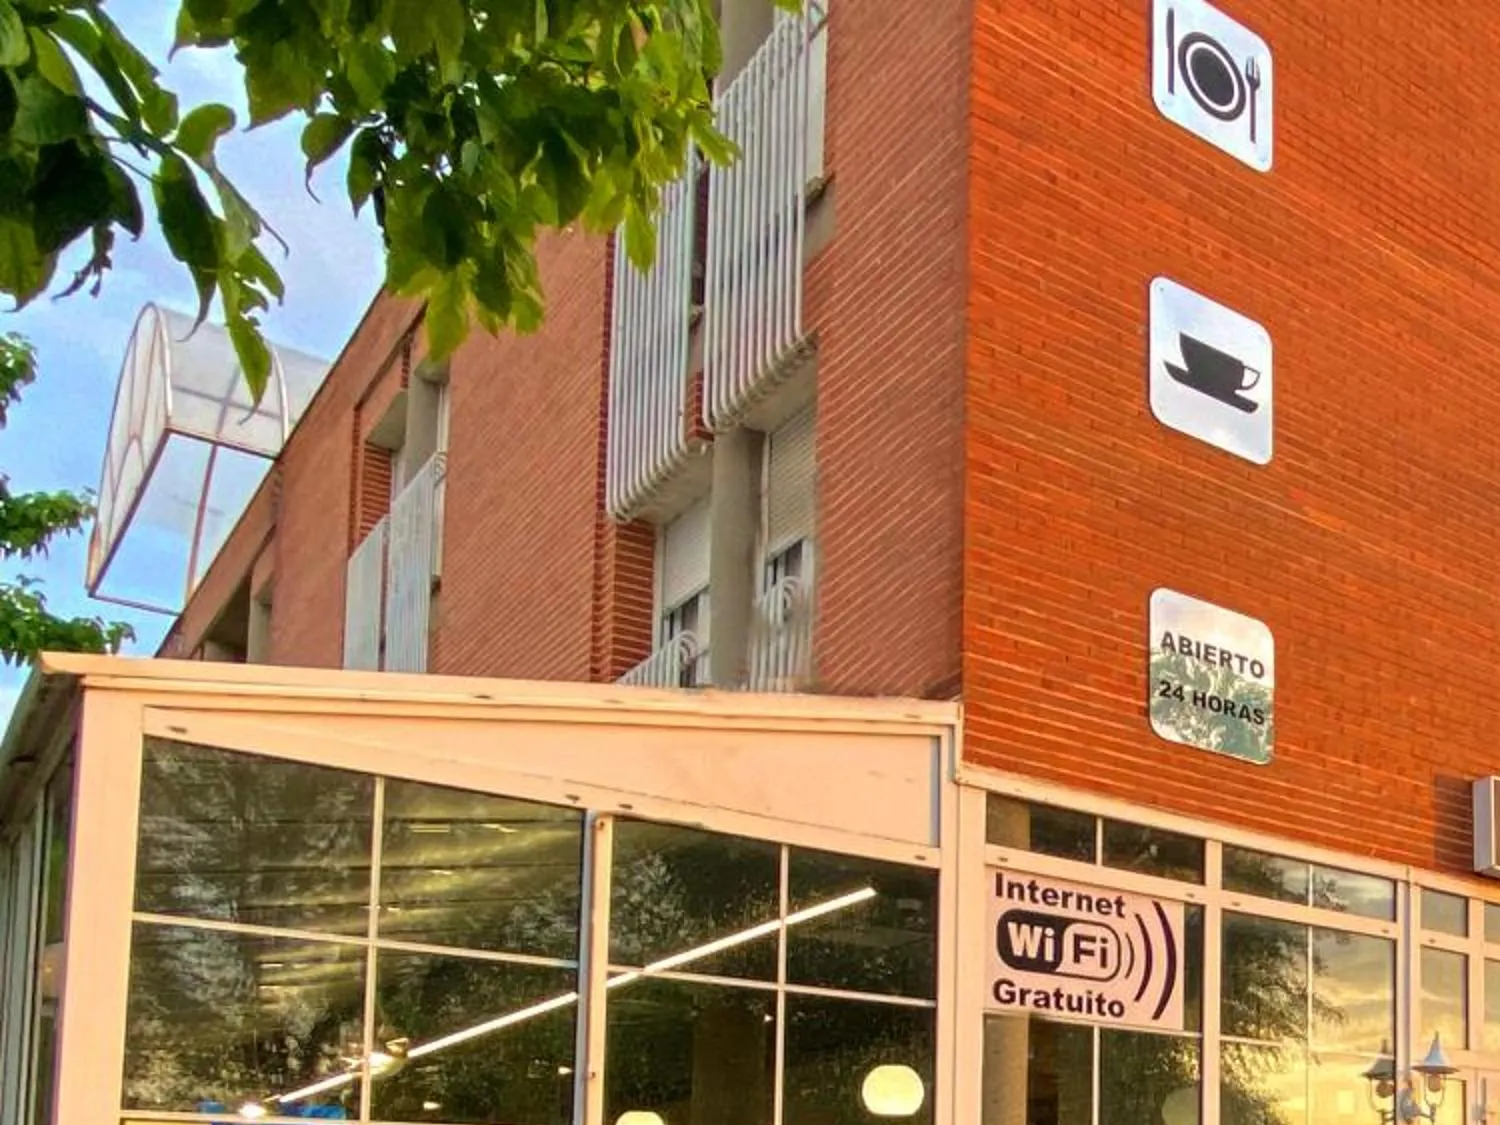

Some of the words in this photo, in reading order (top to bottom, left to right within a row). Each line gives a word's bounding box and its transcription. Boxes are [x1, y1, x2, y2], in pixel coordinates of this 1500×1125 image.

[1160, 630, 1265, 679] ABIERTO
[1159, 680, 1185, 703] 24
[1192, 691, 1265, 726] HORAS
[995, 872, 1126, 919] Internet
[993, 978, 1125, 1019] Gratuito
